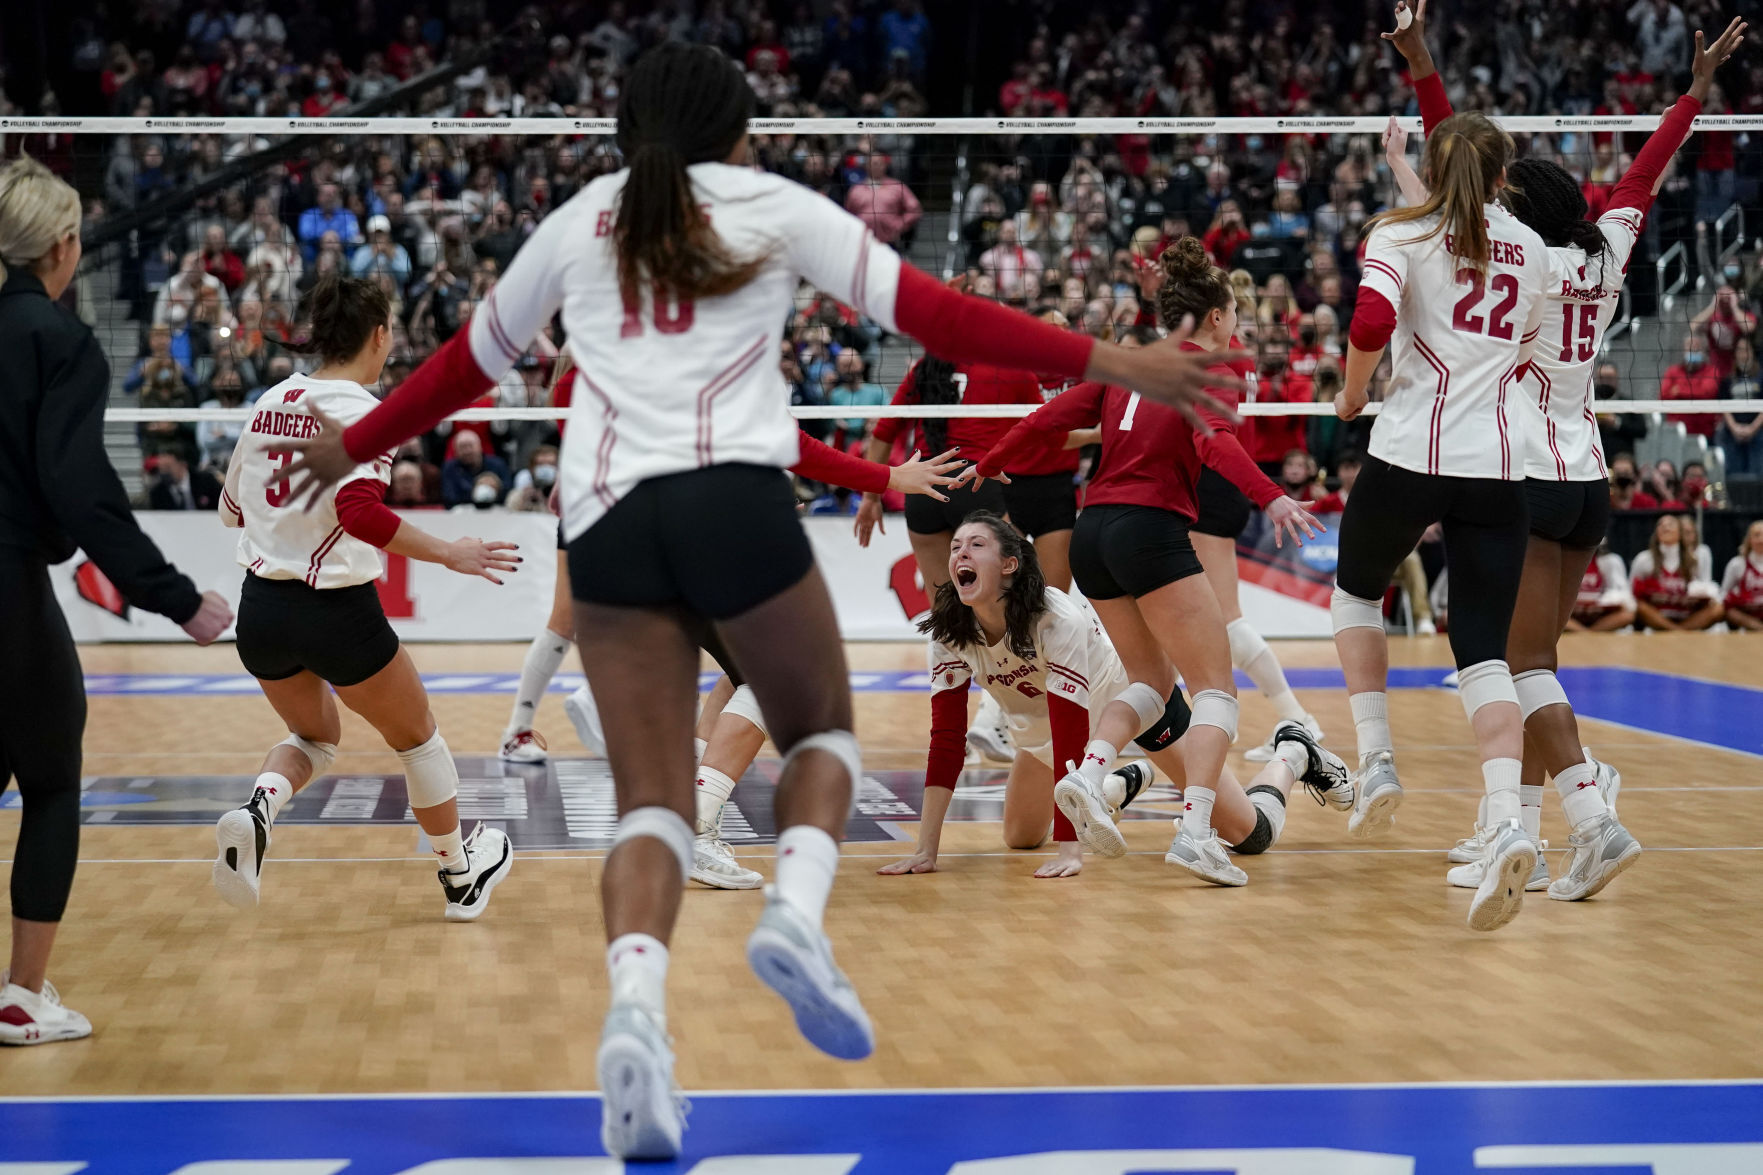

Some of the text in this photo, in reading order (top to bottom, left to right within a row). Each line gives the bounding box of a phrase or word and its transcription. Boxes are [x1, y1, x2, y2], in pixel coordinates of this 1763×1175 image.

[1452, 267, 1519, 341] 22
[1559, 303, 1599, 363] 15
[265, 448, 296, 508] 3
[1016, 681, 1044, 698] 6
